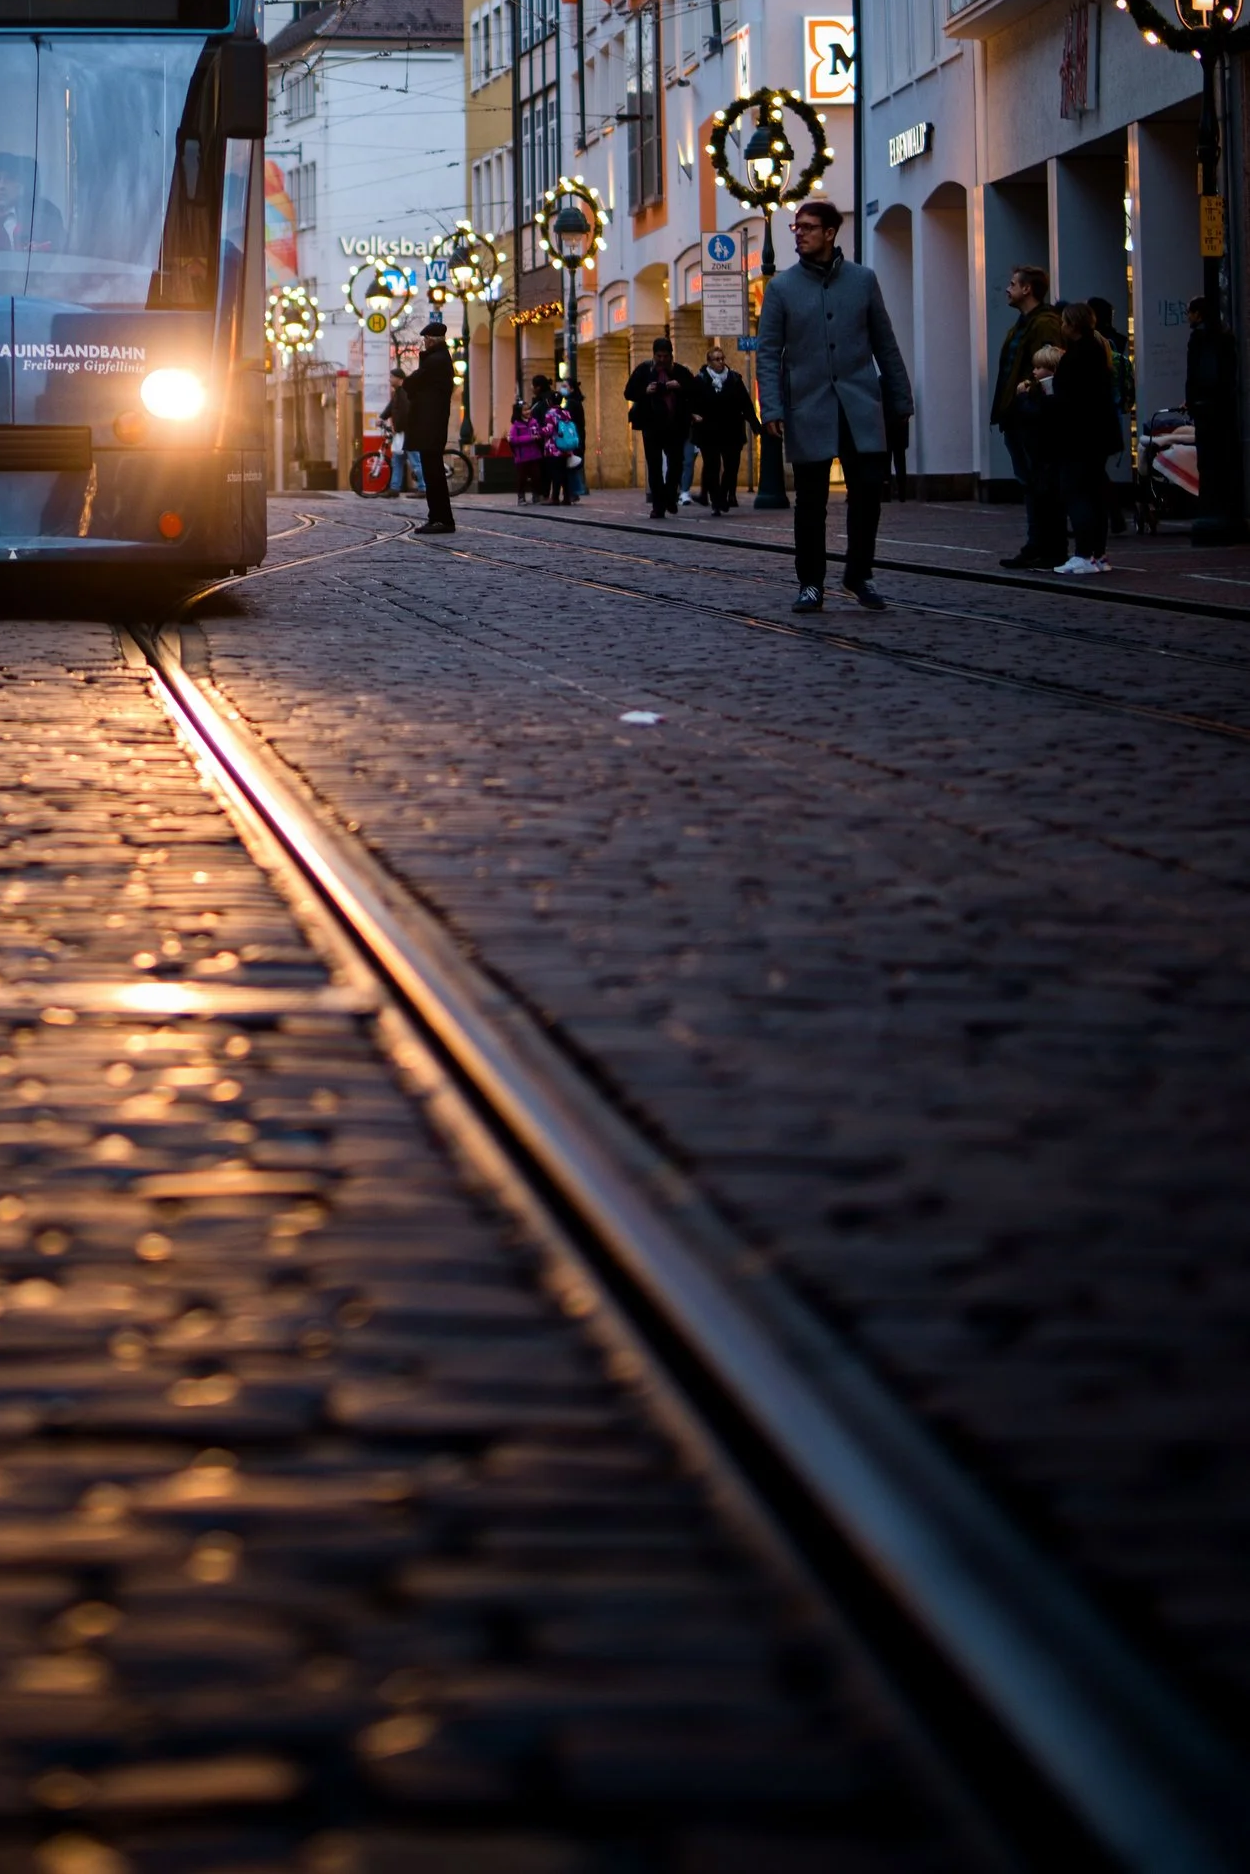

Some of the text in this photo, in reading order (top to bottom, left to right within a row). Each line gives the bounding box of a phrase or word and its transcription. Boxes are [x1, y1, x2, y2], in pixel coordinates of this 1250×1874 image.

[427, 263, 446, 280] W
[711, 262, 732, 271] ZONE
[22, 360, 146, 374] Freiburgs Gipfellinie
